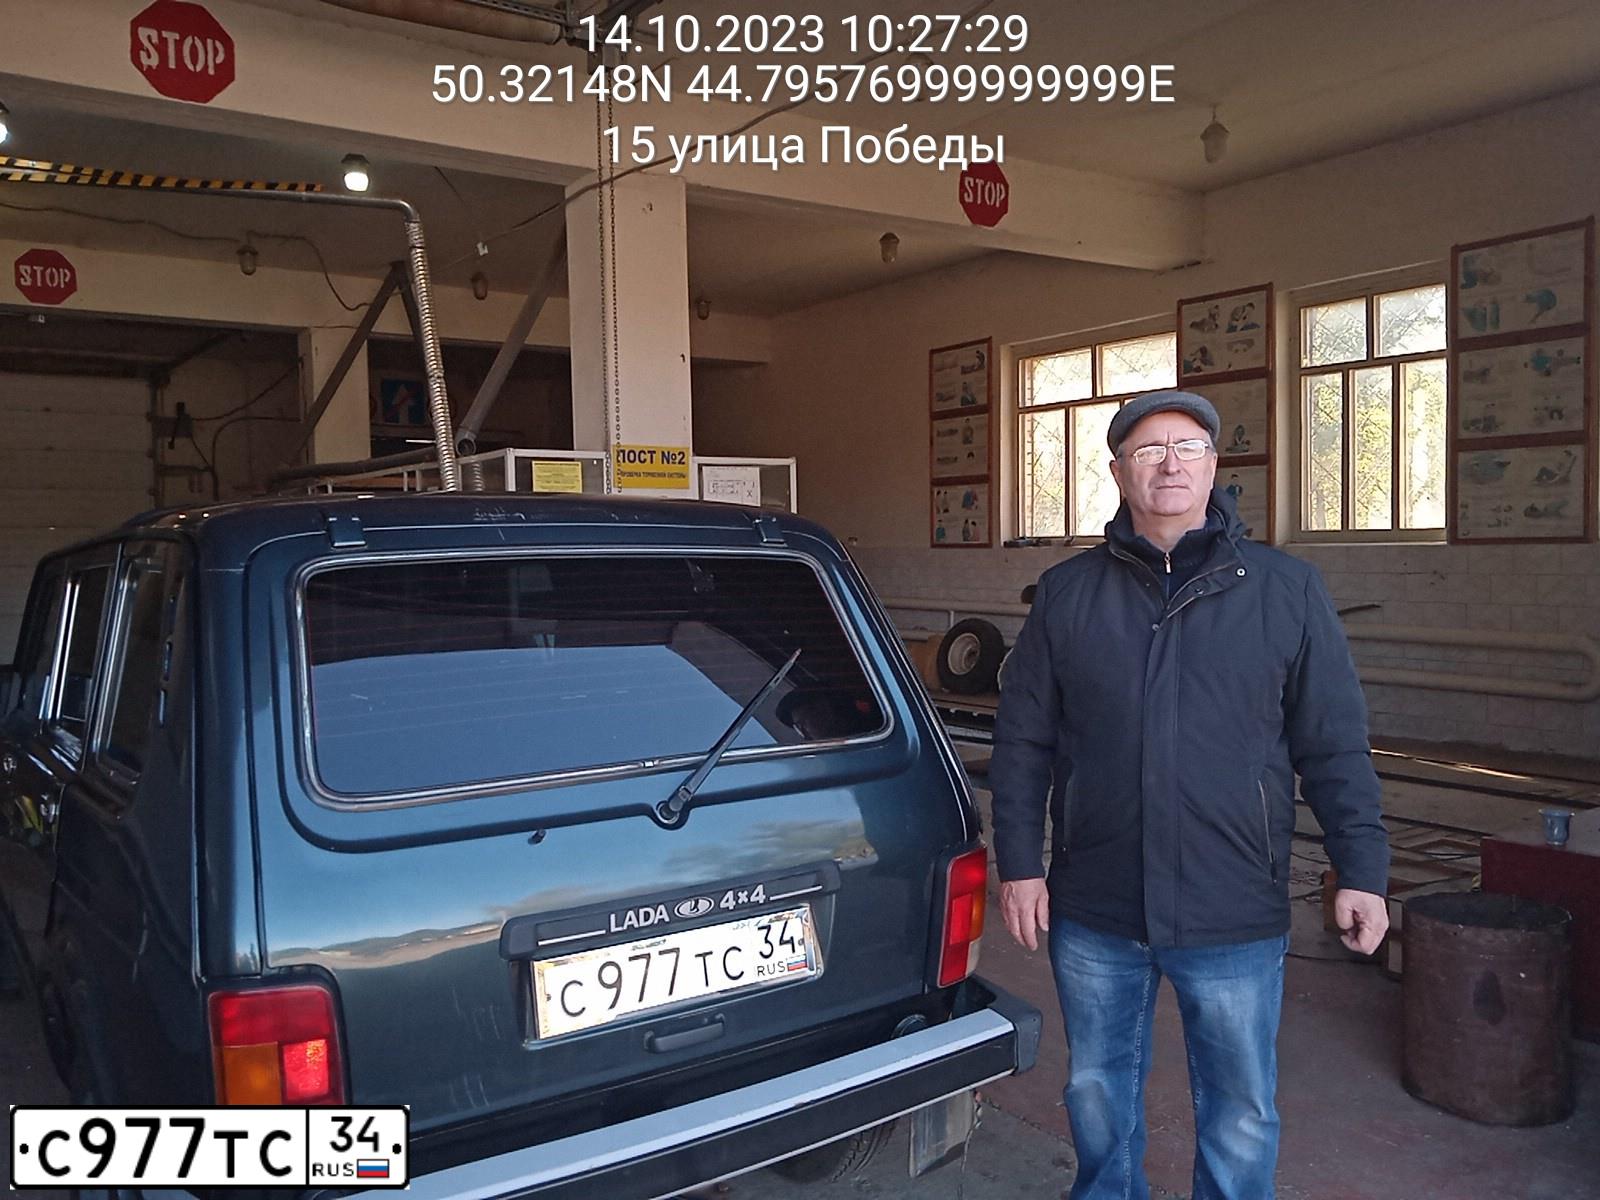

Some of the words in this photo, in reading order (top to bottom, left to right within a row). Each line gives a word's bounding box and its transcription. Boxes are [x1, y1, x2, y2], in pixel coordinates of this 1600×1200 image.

[138, 26, 225, 76] STOP
[963, 176, 1006, 208] STOP
[19, 265, 71, 288] STOP
[661, 450, 685, 465] №2
[609, 904, 670, 933] LADA
[757, 920, 796, 959] 34
[757, 961, 786, 977] RUS
